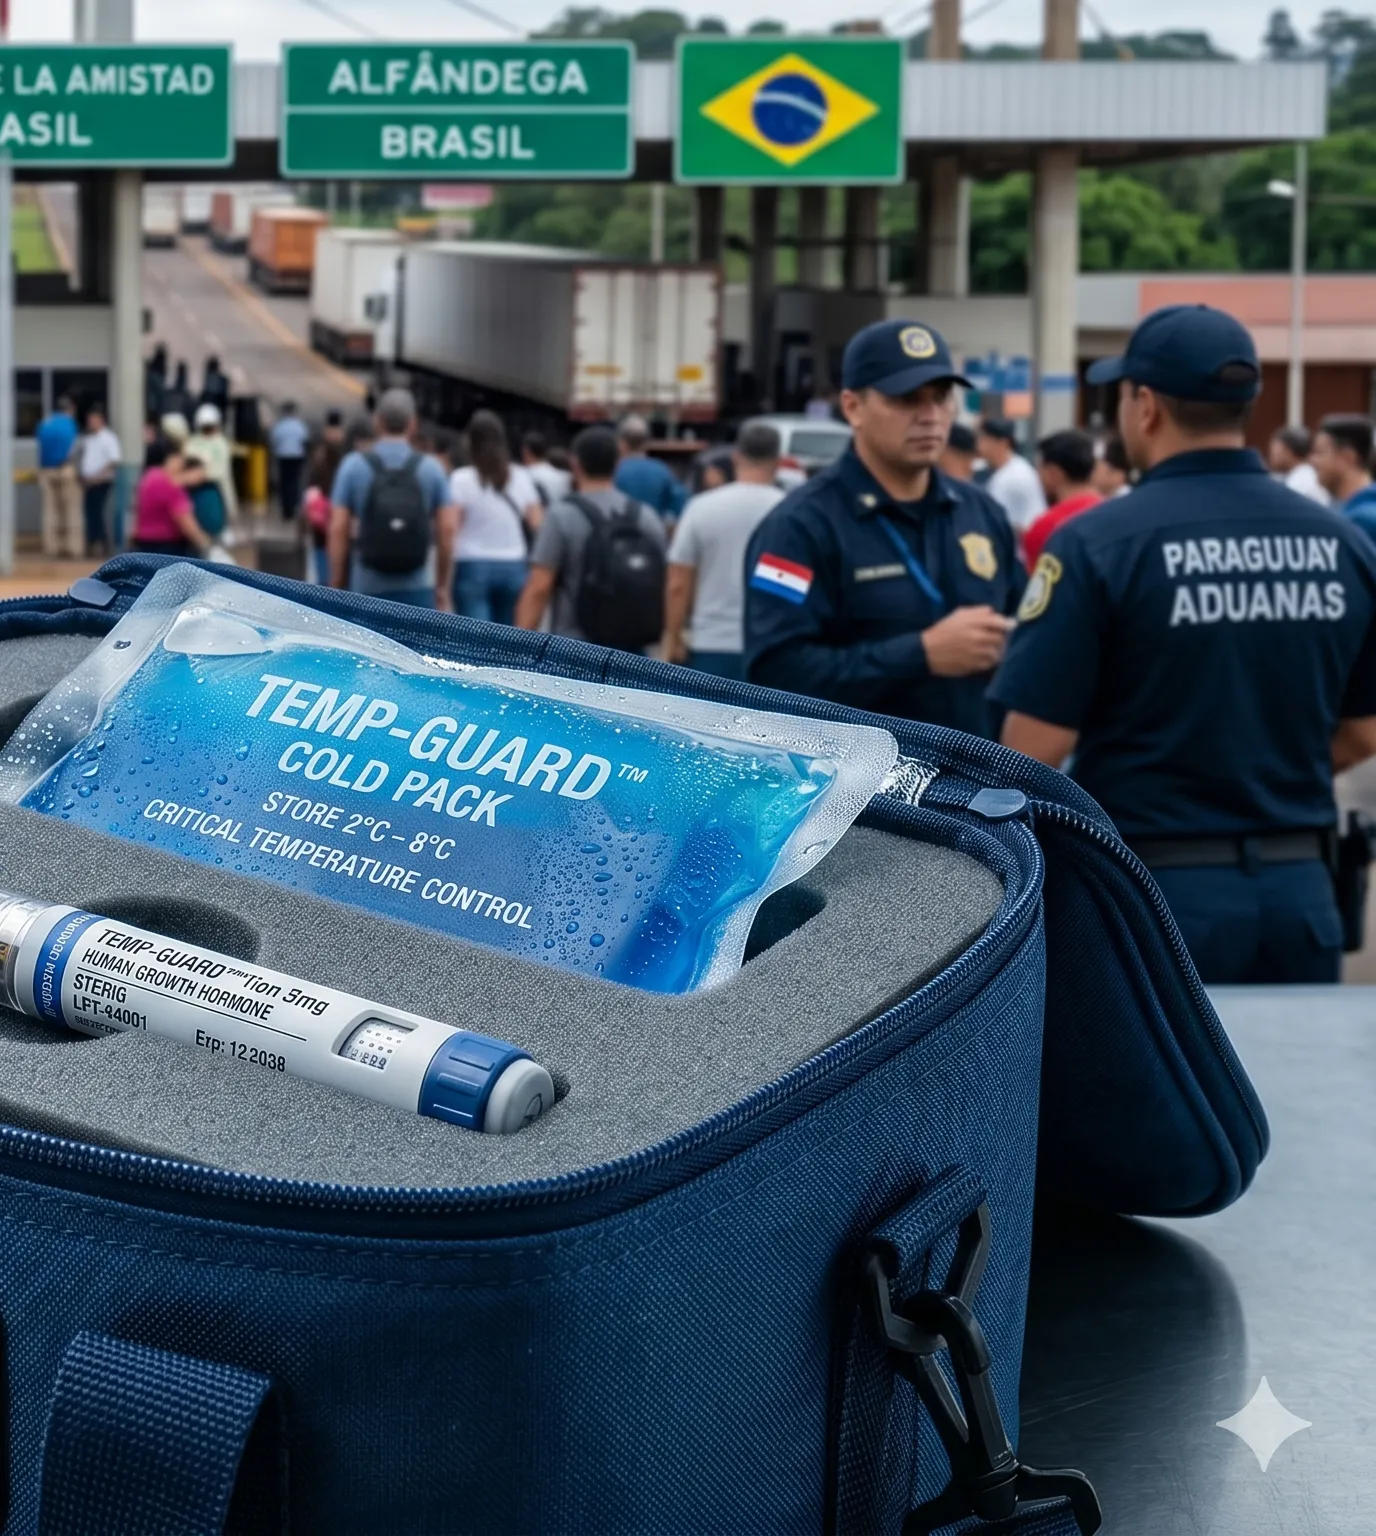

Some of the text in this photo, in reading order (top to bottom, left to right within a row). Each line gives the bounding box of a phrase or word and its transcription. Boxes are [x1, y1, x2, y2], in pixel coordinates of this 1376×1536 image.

[14, 64, 58, 95] LA
[66, 64, 215, 95] AMISTAD
[327, 50, 589, 95] ALFÂNDEGA
[380, 124, 536, 159] BRASIL
[1162, 536, 1339, 578] PARAGUUAY
[1169, 580, 1347, 627] ADUANAS
[278, 741, 514, 828] COLD PACK
[262, 791, 345, 829] STORE
[341, 813, 391, 843] 2°C
[408, 832, 456, 860] 8°C
[143, 798, 533, 929] CRITICAL TEMPERATURE CONTROL
[73, 973, 127, 1003] STERIG
[81, 948, 274, 1021] HUMAN GROWTH HORMONE
